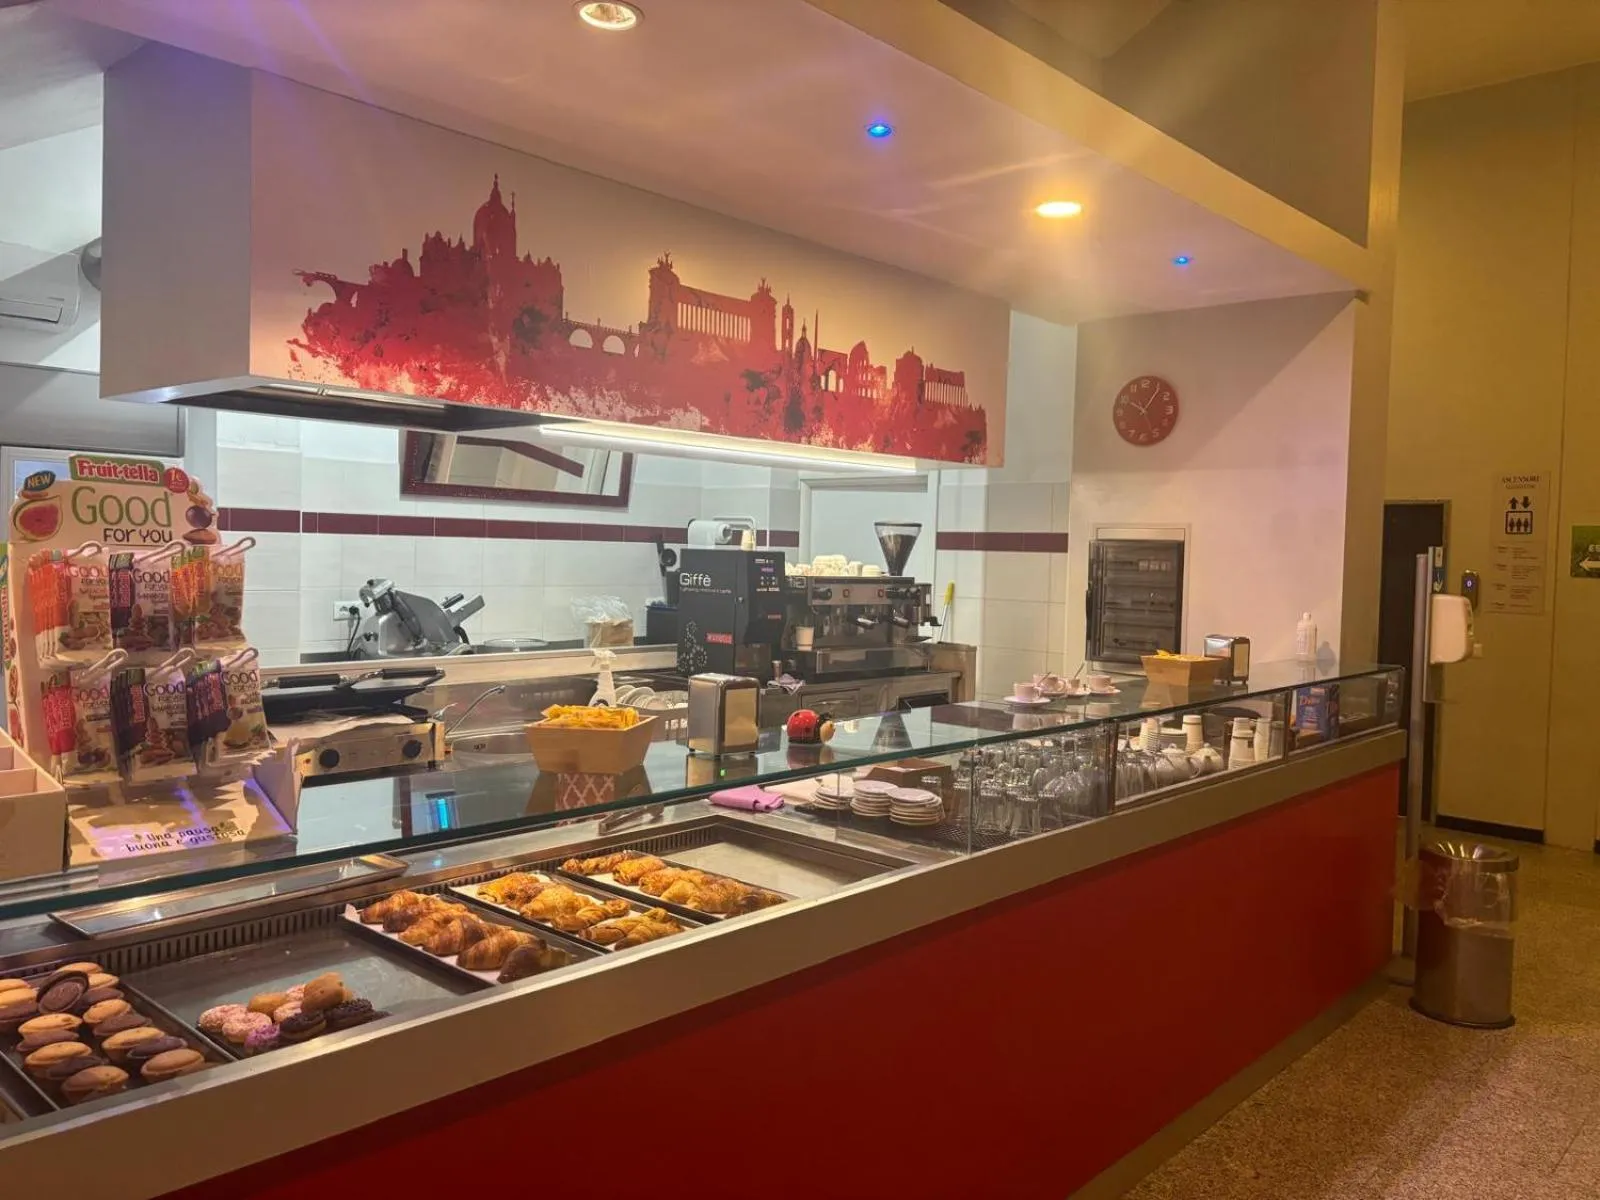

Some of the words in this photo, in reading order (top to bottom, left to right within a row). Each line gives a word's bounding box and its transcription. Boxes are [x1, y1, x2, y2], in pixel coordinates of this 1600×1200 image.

[76, 458, 160, 483] Fruit-tella
[72, 486, 172, 528] Good
[679, 572, 712, 587] Giffè
[126, 841, 171, 852] buona
